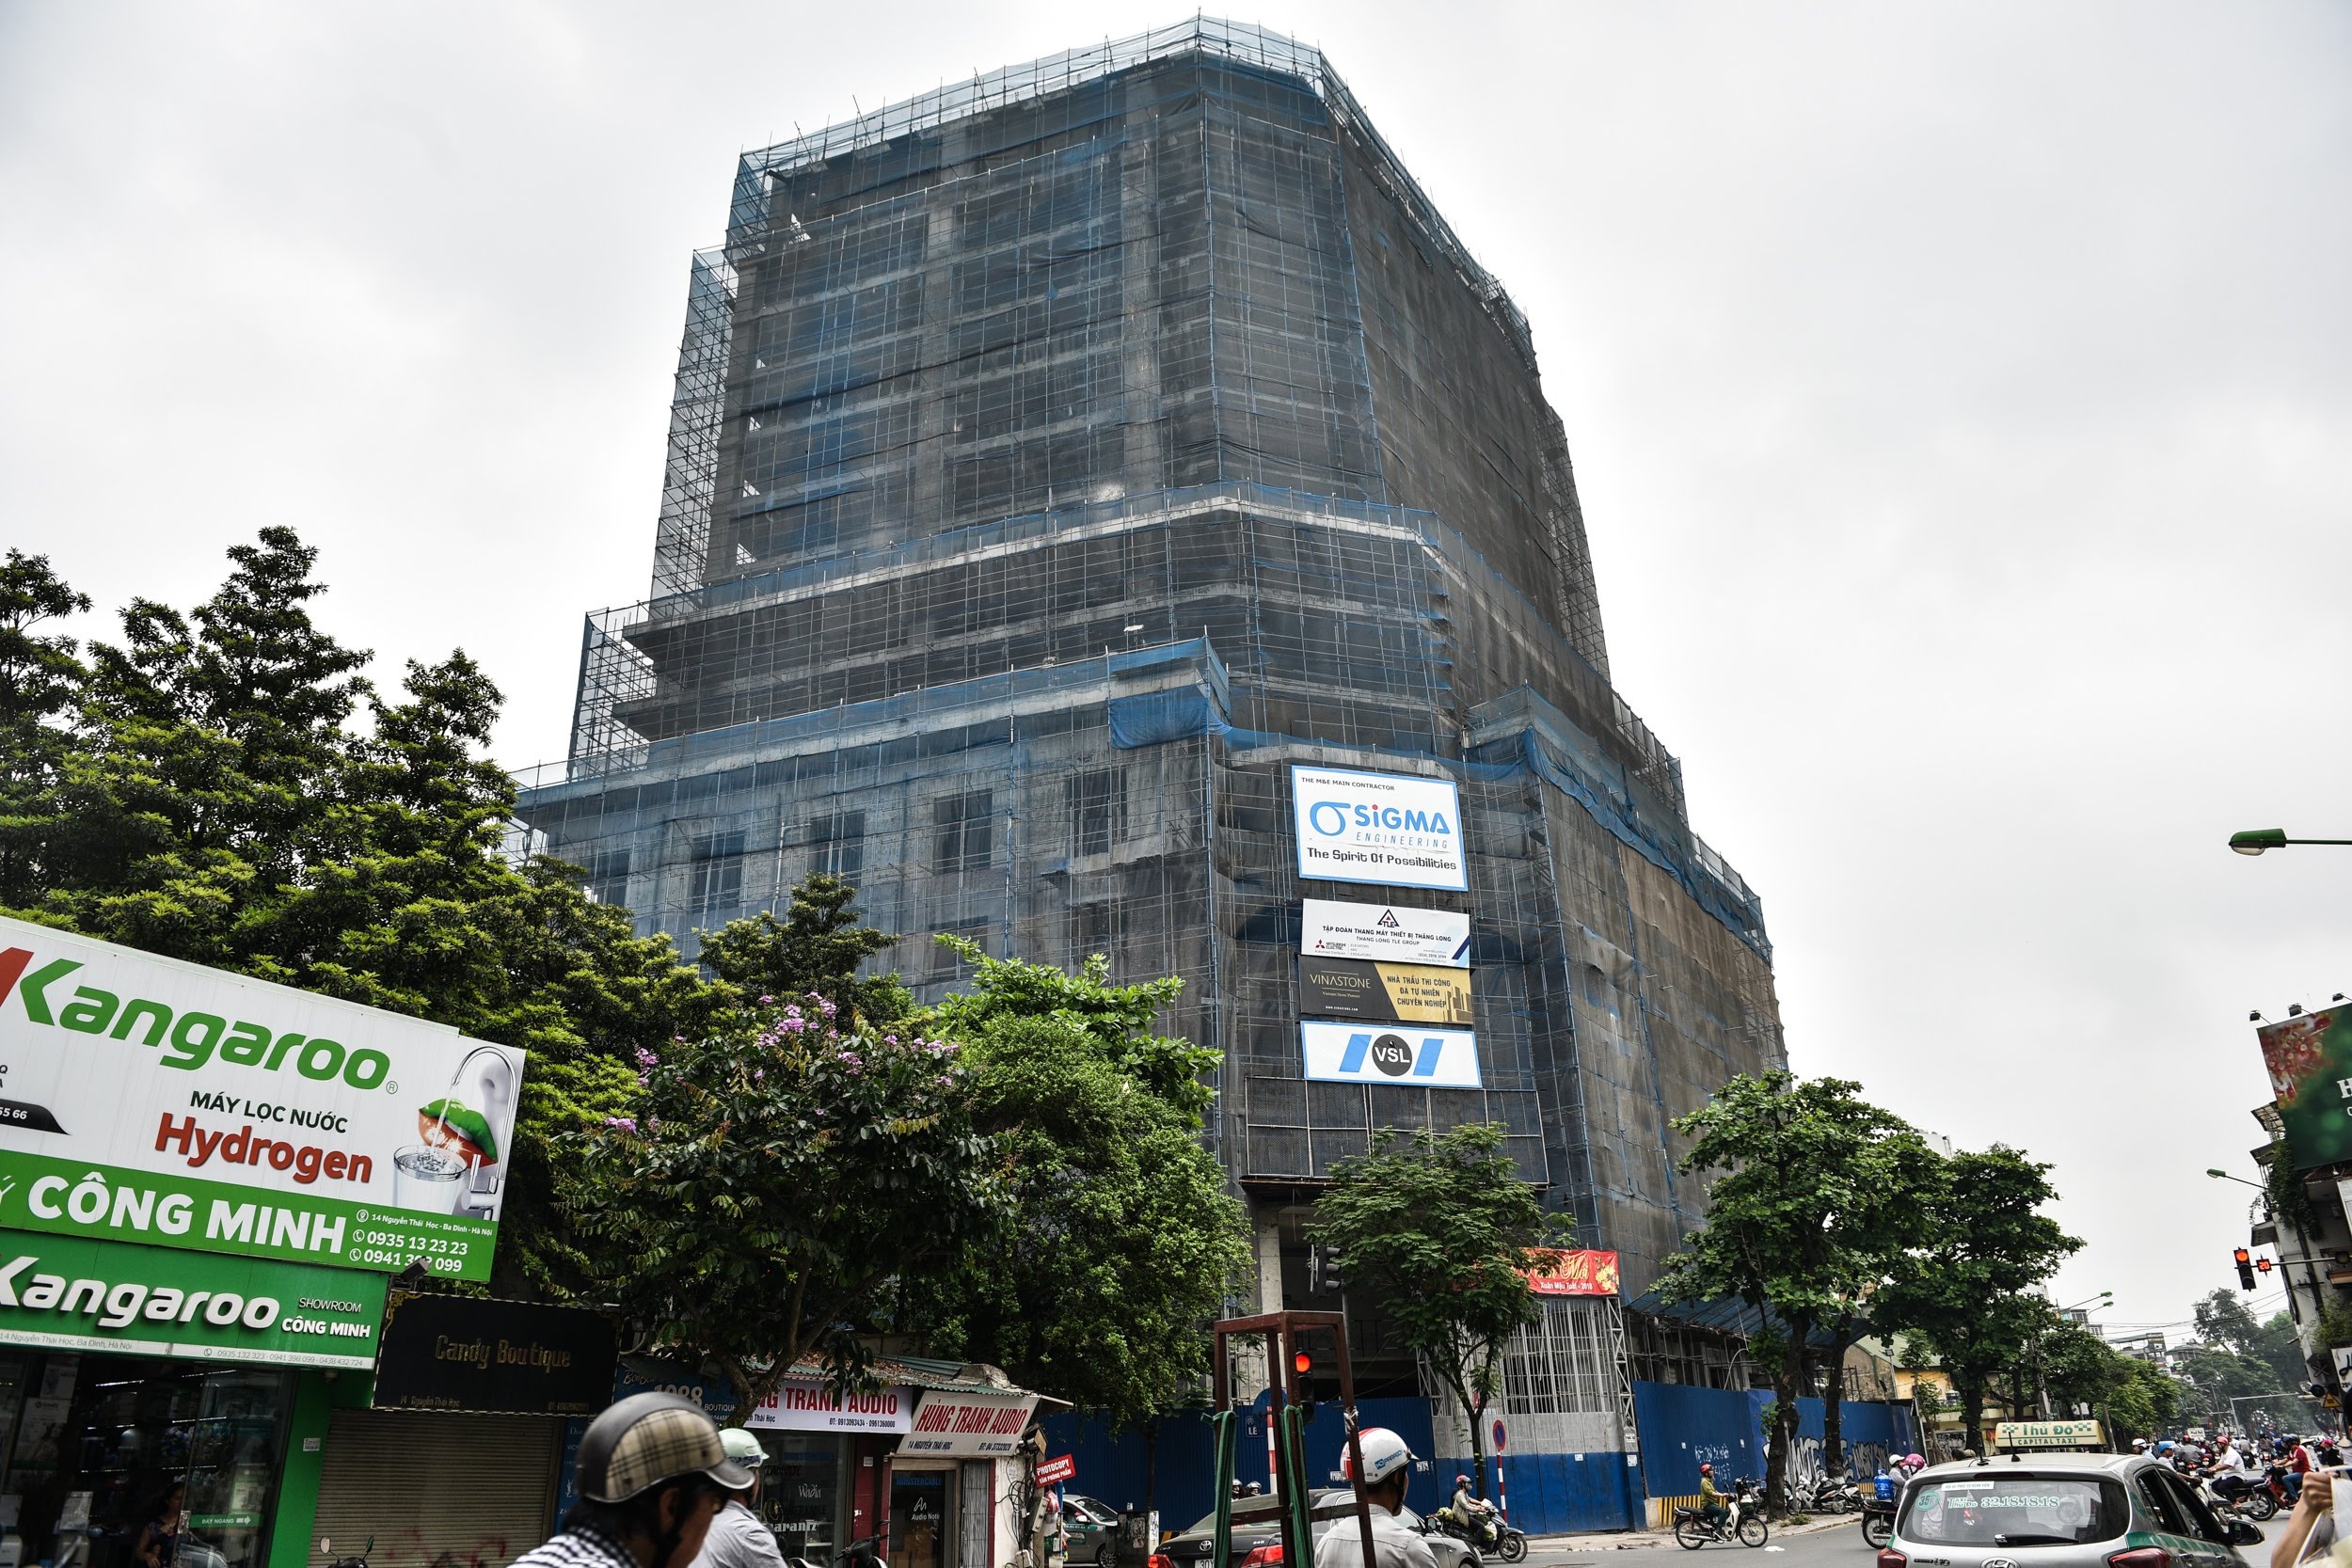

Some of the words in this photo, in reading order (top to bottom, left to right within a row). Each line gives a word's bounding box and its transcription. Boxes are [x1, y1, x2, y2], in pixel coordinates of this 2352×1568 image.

[1352, 782, 1395, 791] CONTRACTOR
[1356, 832, 1448, 849] ENGINEERING
[1307, 847, 1329, 859] The
[1332, 849, 1368, 863] Spirit
[1371, 852, 1383, 863] Of
[1387, 854, 1457, 870] Possibilities
[1375, 928, 1388, 937] MÁY
[1436, 934, 1452, 942] LONG
[1310, 974, 1371, 989] VINASTONE
[1387, 974, 1401, 984] NHÀ
[1422, 976, 1432, 986] THI
[1434, 976, 1451, 987] CÔNG
[1422, 987, 1440, 997] NHIÊN
[1397, 996, 1422, 1007] CHUYÊN
[19, 958, 391, 1091] Kangaroo
[1375, 1046, 1410, 1064] VSL
[12, 1109, 28, 1120] 66
[190, 1089, 241, 1114] MÁY
[244, 1100, 287, 1124] LỌC
[290, 1108, 348, 1133] NƯỚC
[154, 1112, 373, 1184] Hydrogen
[27, 1172, 194, 1236] CÔNG
[205, 1198, 347, 1255] MINH
[372, 1212, 382, 1222] 14
[382, 1215, 408, 1226] Nguyễn
[408, 1217, 423, 1227] Thái
[425, 1220, 438, 1230] Học
[443, 1223, 453, 1231] Ba
[453, 1223, 468, 1233] Đình
[471, 1227, 481, 1235] Hà
[482, 1227, 493, 1237] Nội
[367, 1230, 405, 1248] 0935
[408, 1236, 426, 1251] 13
[429, 1238, 447, 1254] 23
[450, 1241, 469, 1256] 23
[363, 1248, 401, 1266] 0941
[435, 1257, 463, 1273] 099
[2259, 1261, 2270, 1270] 20
[0, 1255, 280, 1328] Kangaroo
[298, 1297, 362, 1313] SHOWROOM
[281, 1316, 326, 1335] CÔNG
[329, 1322, 372, 1338] MINH
[10, 1333, 40, 1344] Nguyễn
[41, 1335, 57, 1344] Thái
[77, 1338, 87, 1347] Ba
[119, 1341, 133, 1351] Nội
[217, 1349, 236, 1358] 0935
[236, 1350, 251, 1359] 132
[251, 1351, 265, 1360] 323
[269, 1353, 287, 1362] 0941
[288, 1354, 303, 1363] 398
[303, 1354, 316, 1364] 099
[436, 1334, 492, 1370] Candy
[496, 1338, 573, 1374] Boutique
[848, 1392, 898, 1415] AUDIO
[755, 1414, 765, 1422] Thái
[766, 1414, 776, 1424] Học
[950, 1405, 995, 1434] TRANH
[987, 1407, 1028, 1435] AUDIO
[1037, 1458, 1070, 1476] PHOTOCOPY
[1980, 1496, 2060, 1509] 32.18.18.18
[911, 1513, 928, 1521] Audio
[928, 1512, 940, 1520] Note
